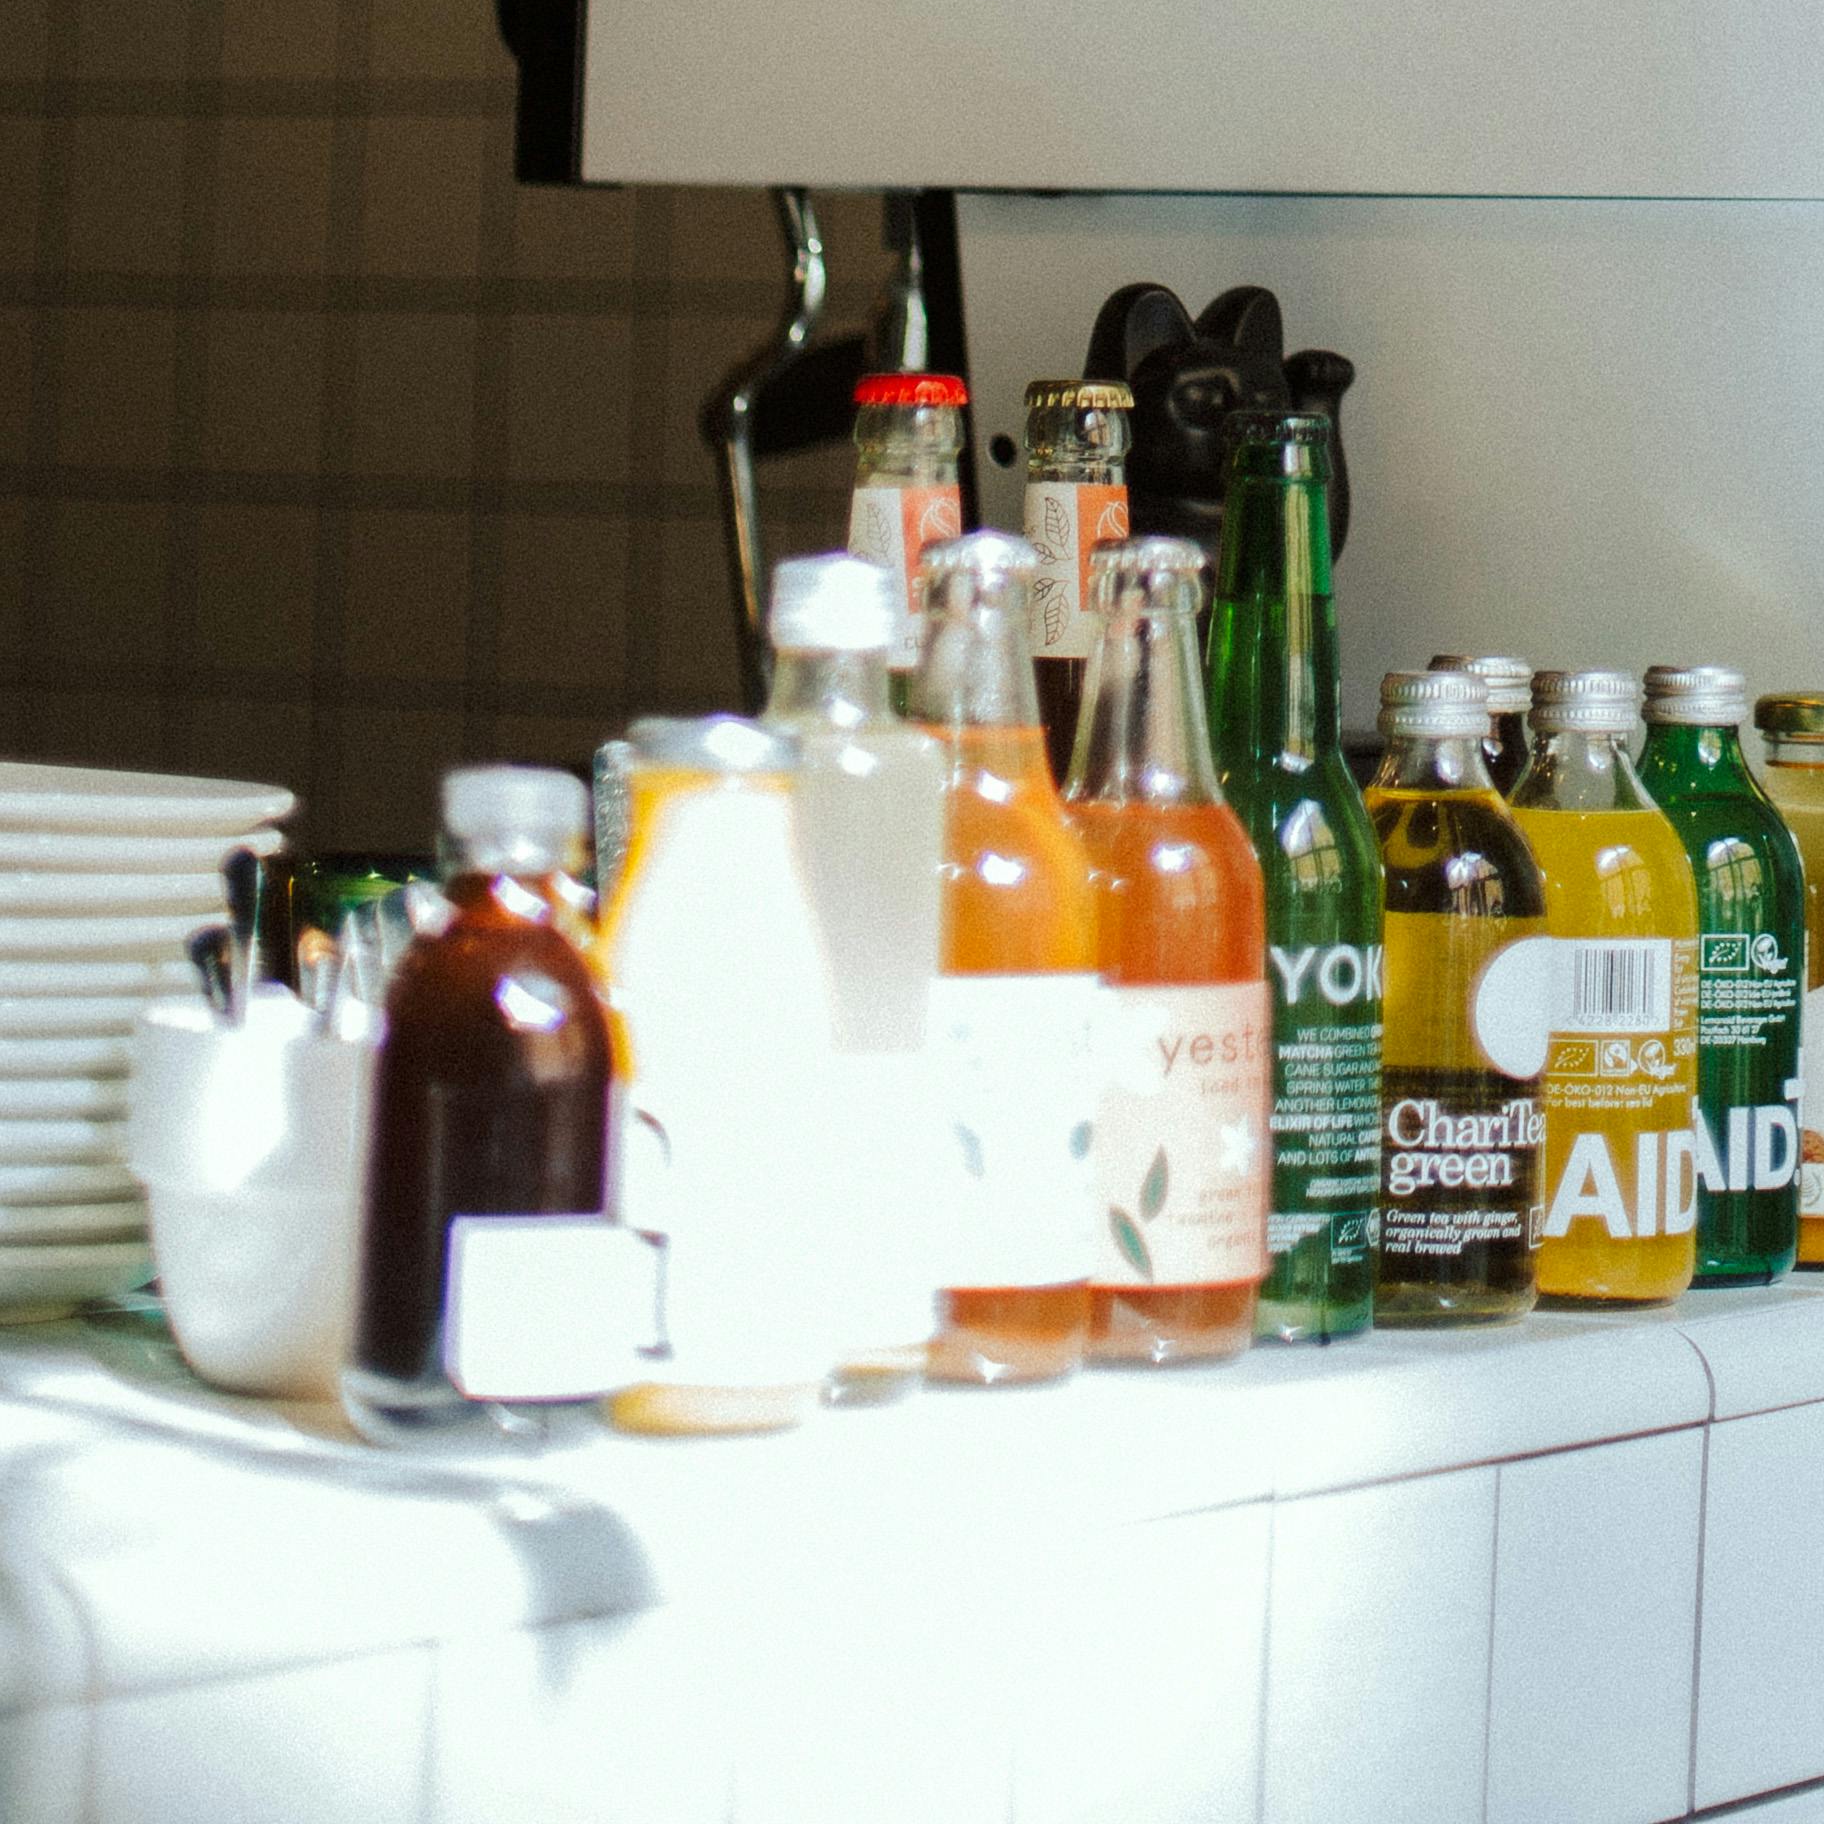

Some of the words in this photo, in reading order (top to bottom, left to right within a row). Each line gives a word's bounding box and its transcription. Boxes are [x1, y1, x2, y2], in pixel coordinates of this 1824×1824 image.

[1320, 1025, 1370, 1040] COMBINED
[1278, 1044, 1333, 1059] MATCHA
[1334, 1043, 1366, 1058] GREEN
[1284, 1063, 1320, 1078] CANE
[1323, 1061, 1358, 1077] SUGAR
[1286, 1081, 1333, 1096] SPRING
[1334, 1079, 1366, 1094] WATER
[1275, 1098, 1334, 1113] ANOTHER
[1269, 1115, 1311, 1131] ELIXIR
[1330, 1114, 1353, 1129] LIFE
[1388, 1098, 1547, 1148] ChariTea
[1308, 1132, 1358, 1147] NATURAL
[1277, 1151, 1306, 1167] AND
[1309, 1151, 1339, 1167] LOTS
[1388, 1152, 1514, 1196] green
[1543, 1129, 1697, 1238] AID
[1386, 1208, 1426, 1224] Green
[1430, 1209, 1450, 1225] tea
[1452, 1210, 1480, 1225] with
[1385, 1225, 1464, 1243] organically
[1463, 1227, 1501, 1243] grown
[1502, 1225, 1522, 1238] and
[1385, 1240, 1411, 1253] real
[1414, 1241, 1462, 1255] brewed
